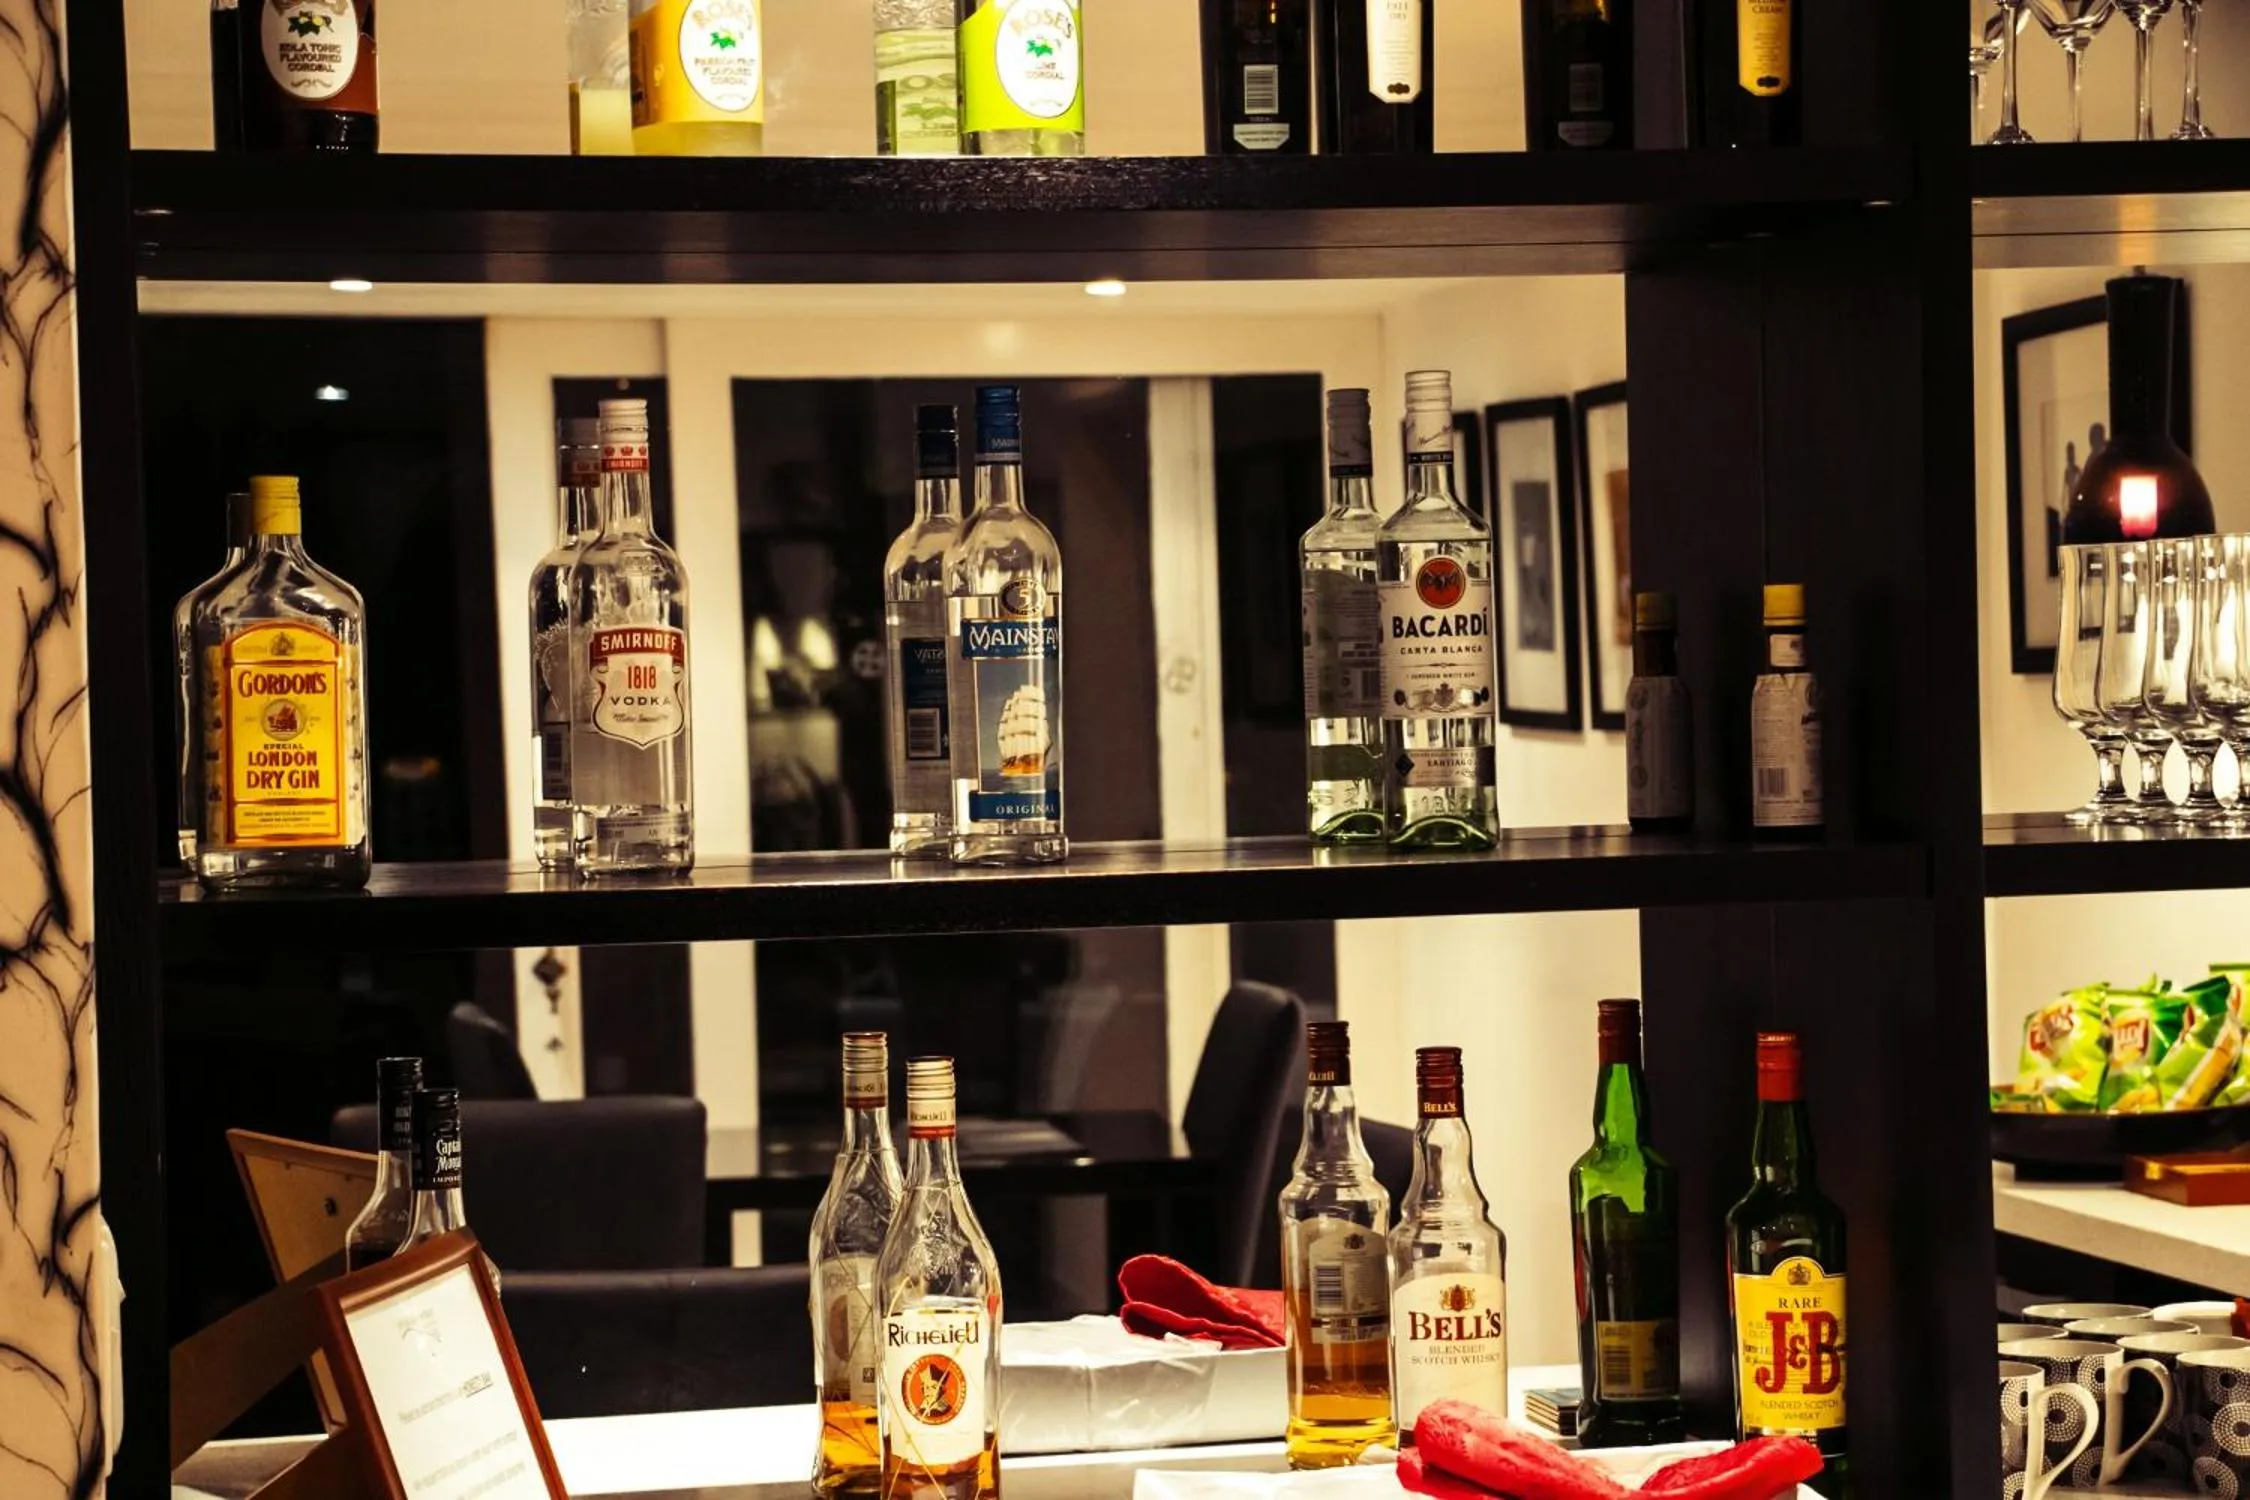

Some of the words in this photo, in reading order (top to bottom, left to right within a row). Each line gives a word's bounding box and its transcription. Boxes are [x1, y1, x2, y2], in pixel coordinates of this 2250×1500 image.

[1392, 606, 1488, 638] BACARDÍ
[600, 632, 677, 651] SMIRNOFF
[1400, 646, 1436, 655] CARTA
[1442, 644, 1483, 654] BLANCA
[238, 670, 327, 697] GORDON'S
[627, 665, 656, 689] 1818
[610, 696, 672, 706] VODKA
[248, 751, 318, 766] LONDON
[246, 770, 285, 789] DRY
[288, 769, 320, 789] GIN
[995, 803, 1055, 815] ORIGINAL
[1423, 1101, 1457, 1113] BELL'S
[1778, 1297, 1822, 1309] RARE
[1408, 1307, 1502, 1341] BELL'S
[1411, 1355, 1457, 1365] SCOTCH
[1460, 1353, 1501, 1365] WHISKY
[1755, 1310, 1841, 1395] J&B
[1760, 1399, 1802, 1410] BLENDED
[1803, 1398, 1839, 1410] SCOTCH
[1783, 1411, 1821, 1421] WHISKY
